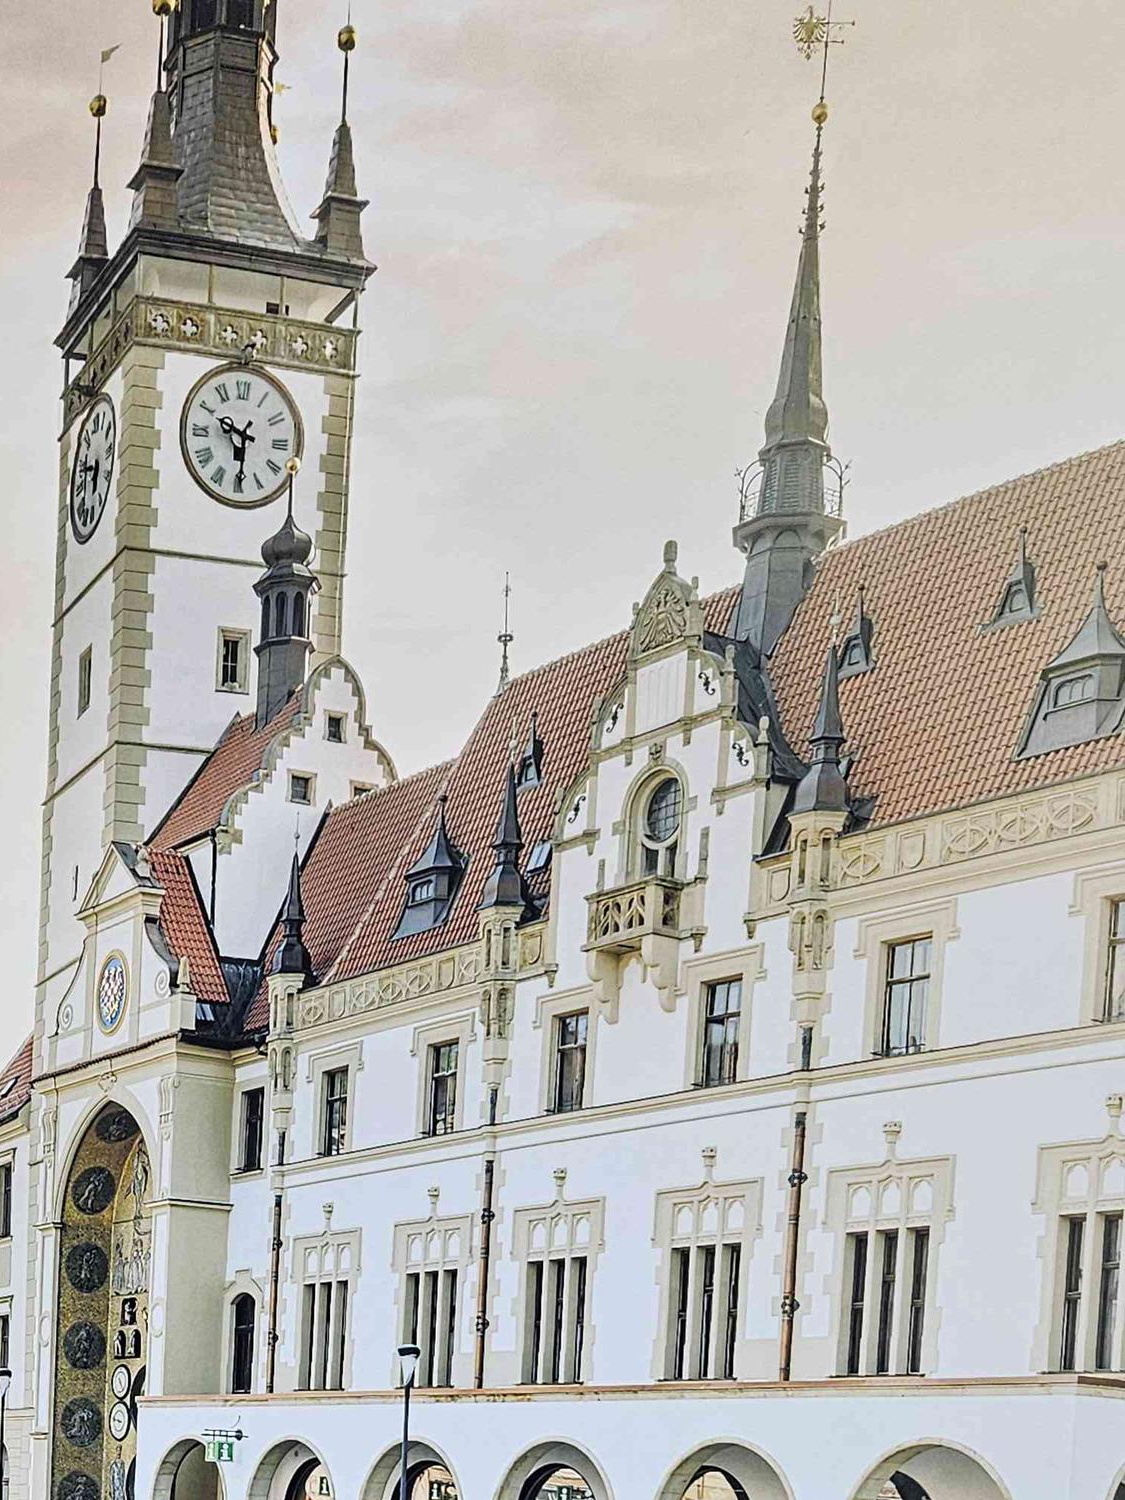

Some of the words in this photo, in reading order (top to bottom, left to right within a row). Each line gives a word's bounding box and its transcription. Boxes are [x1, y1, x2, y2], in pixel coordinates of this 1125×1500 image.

[236, 380, 251, 400] XII
[267, 411, 285, 427] II
[271, 439, 289, 451] III
